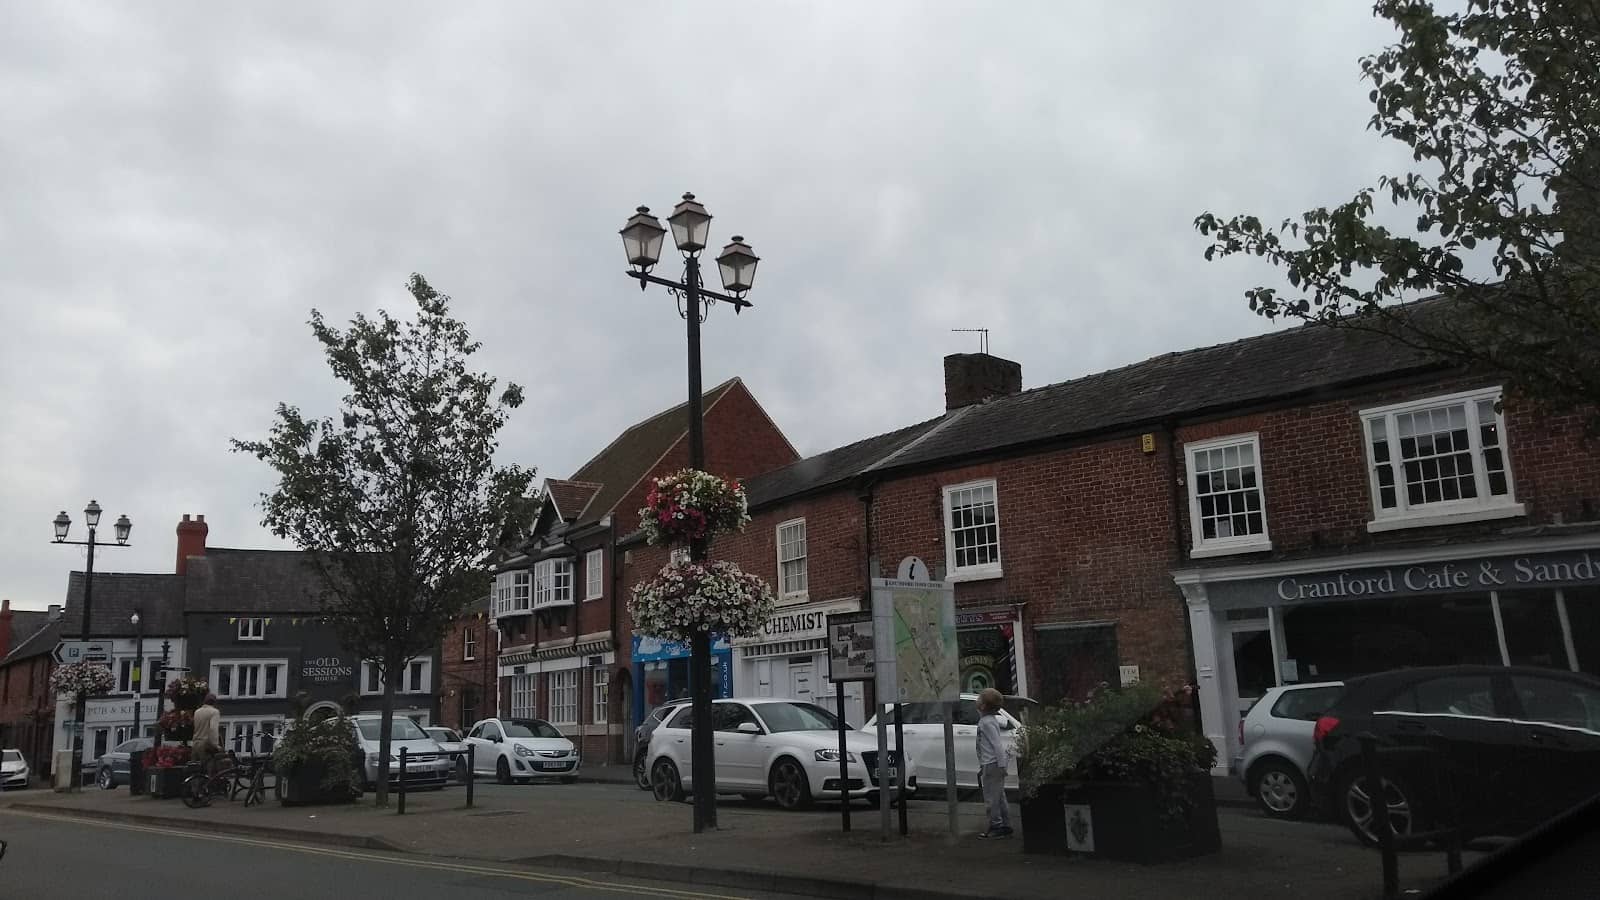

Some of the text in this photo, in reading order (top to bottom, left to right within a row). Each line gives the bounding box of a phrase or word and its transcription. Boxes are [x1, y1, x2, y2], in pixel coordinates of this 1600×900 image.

[1277, 569, 1396, 601] Cranford
[1404, 564, 1470, 591] Cafe
[1479, 560, 1505, 585] &
[764, 611, 824, 635] CHEMIST
[316, 657, 340, 667] OLD
[302, 666, 352, 677] SESSIONS
